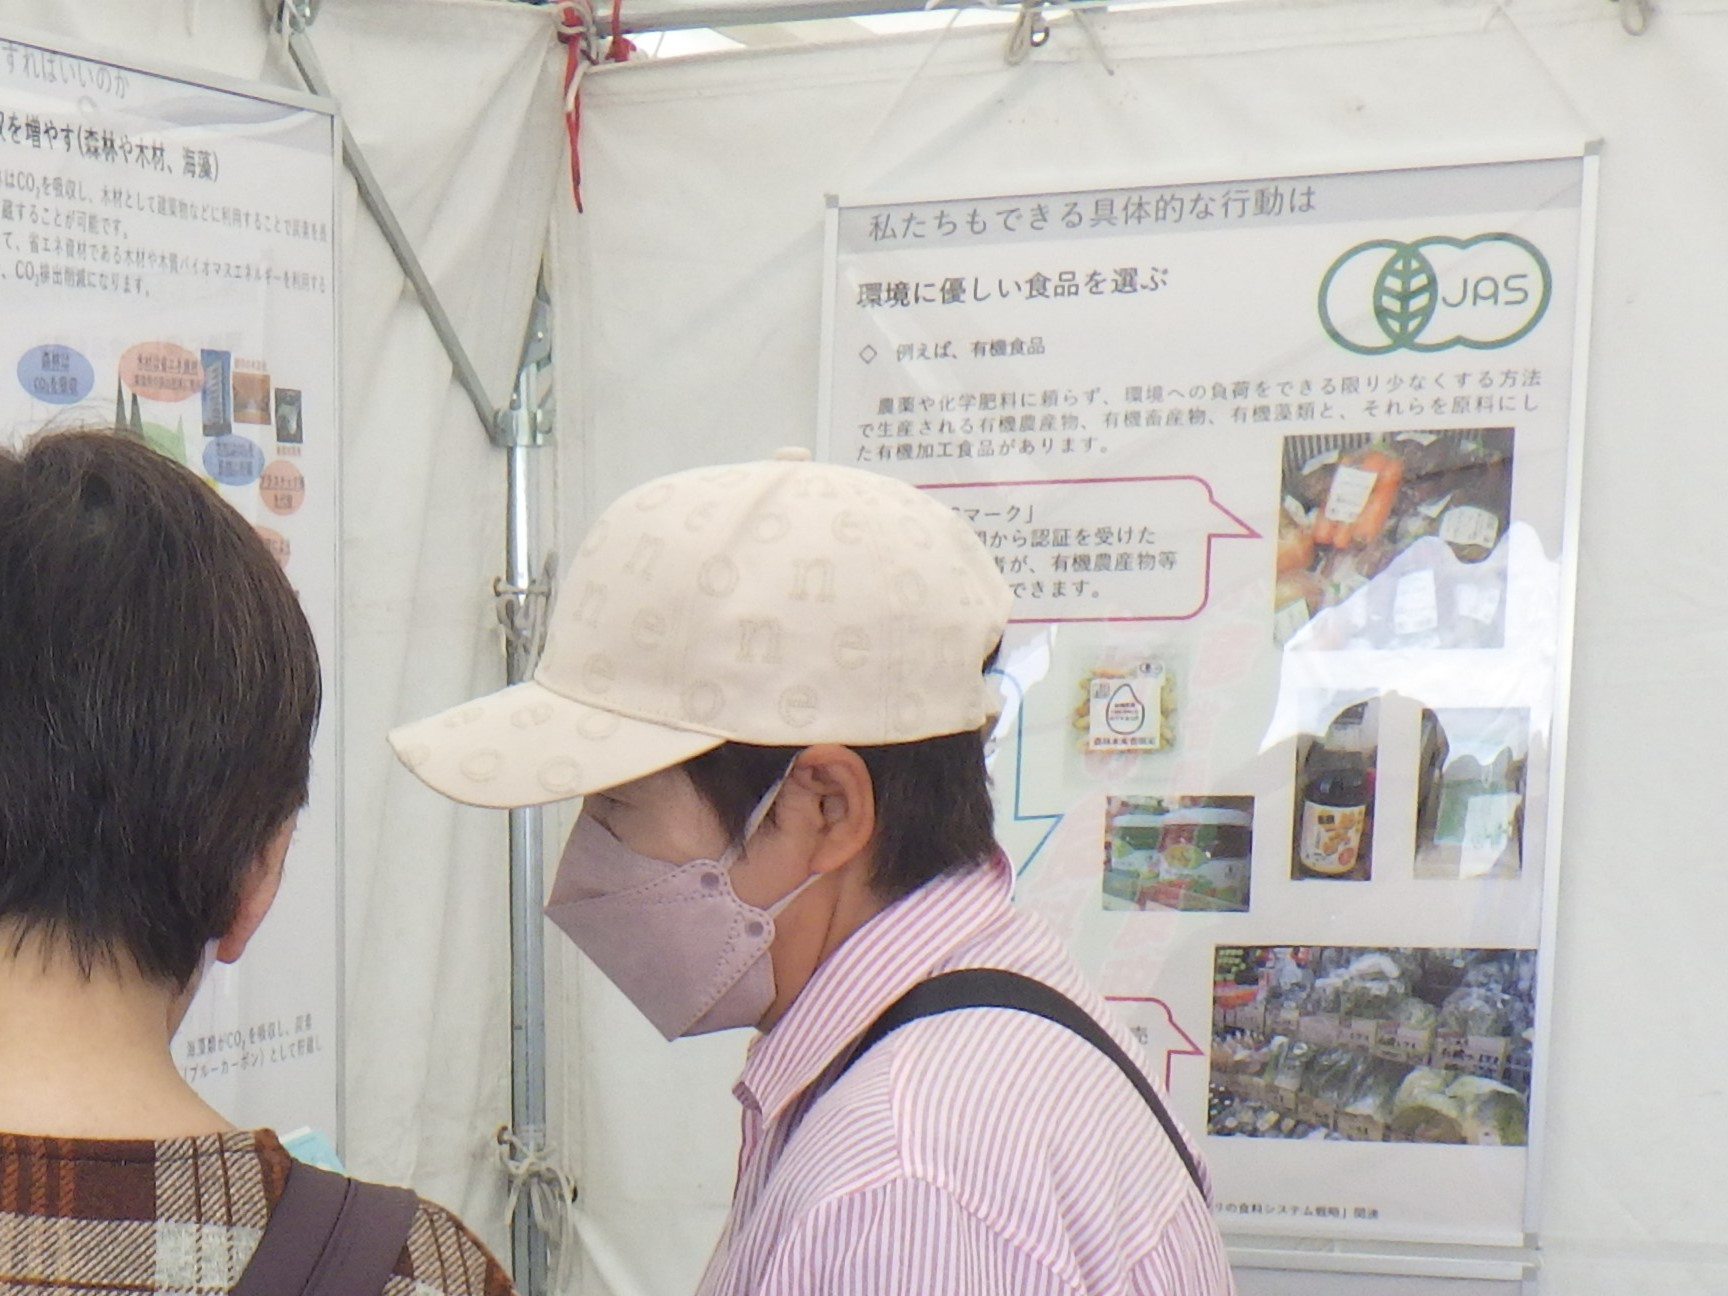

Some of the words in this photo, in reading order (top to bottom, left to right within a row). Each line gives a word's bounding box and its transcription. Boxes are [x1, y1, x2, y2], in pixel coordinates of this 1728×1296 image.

[868, 185, 1317, 242] 私たちもできる具体的な行動は
[856, 266, 1170, 308] 環境に優しい食品を選ぶ
[1441, 270, 1530, 309] JAS
[951, 504, 1035, 525] マーク」
